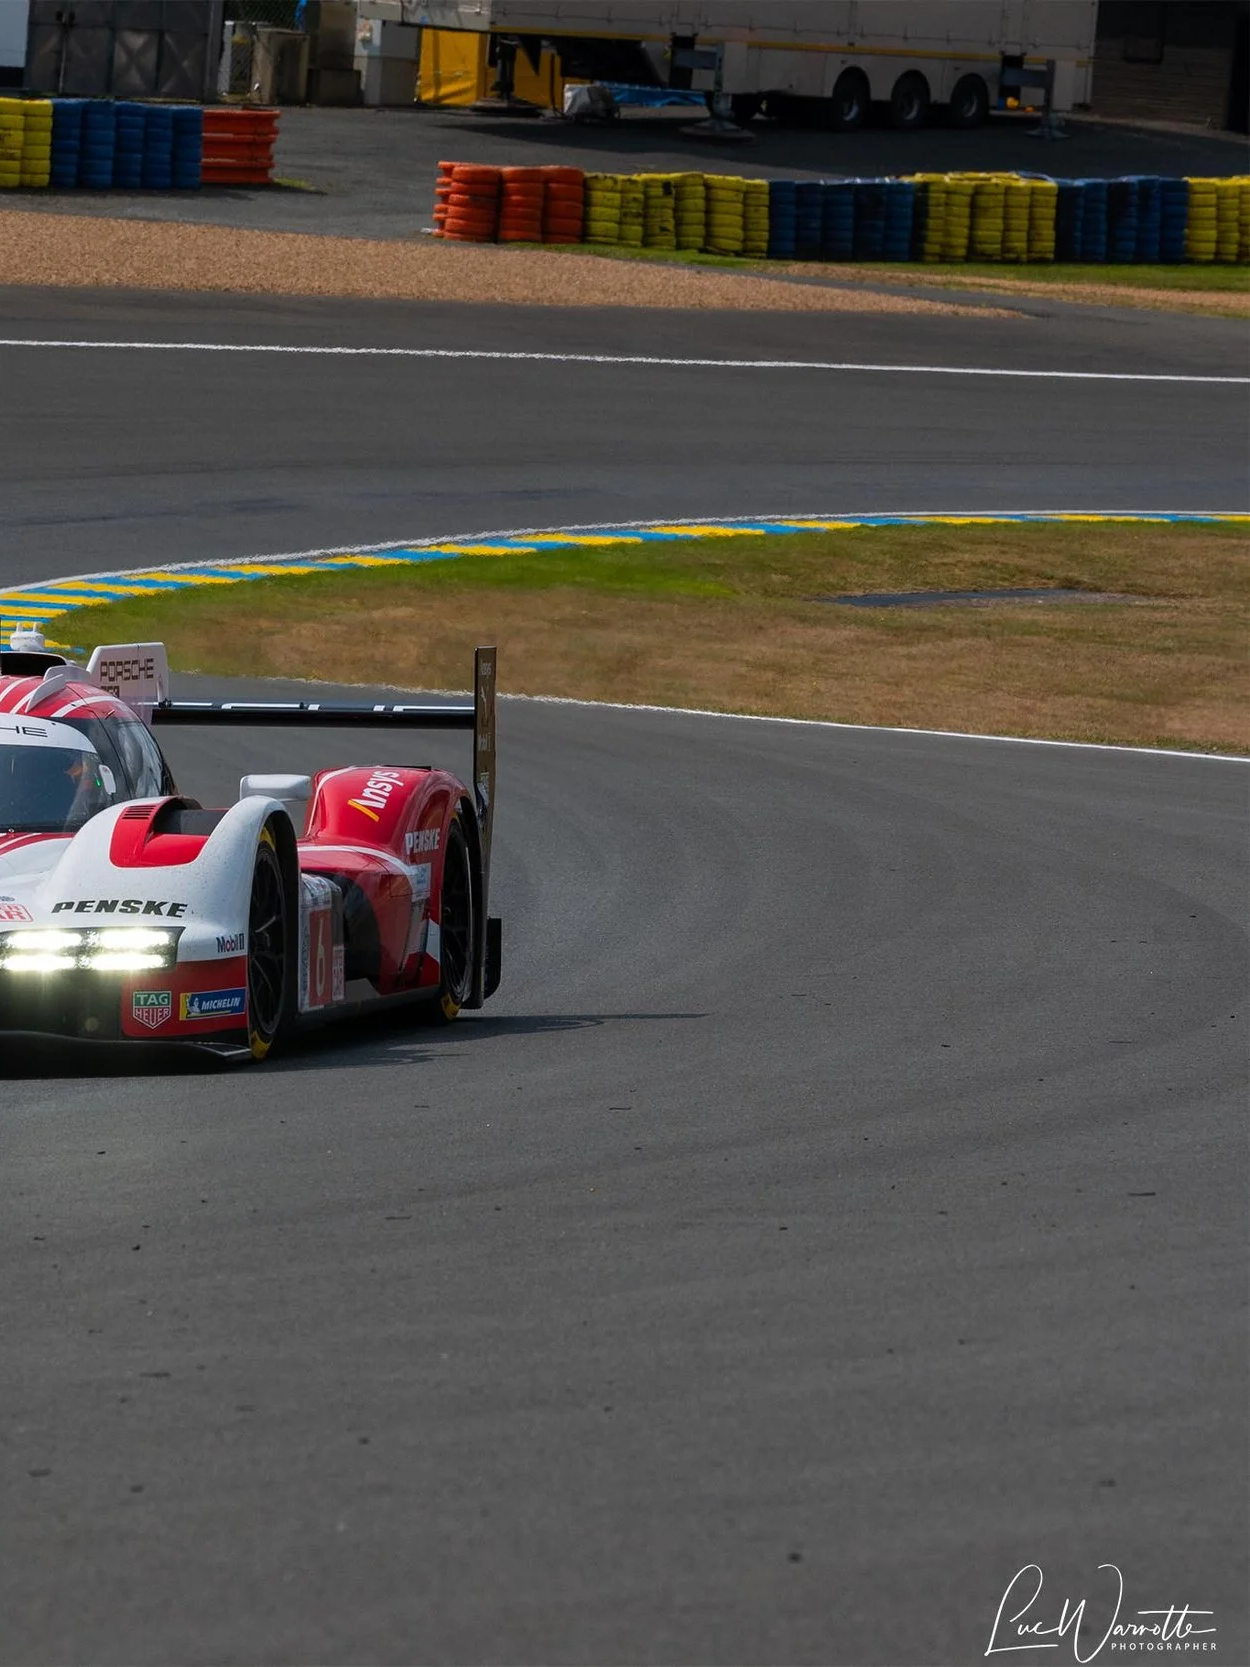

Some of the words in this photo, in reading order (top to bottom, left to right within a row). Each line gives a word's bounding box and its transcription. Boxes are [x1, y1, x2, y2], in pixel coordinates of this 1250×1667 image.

[100, 658, 154, 682] PORSCHE
[405, 828, 440, 856] PENSKE
[51, 899, 188, 918] PENSKE
[316, 917, 326, 997] 6
[136, 994, 169, 1005] TAG
[201, 996, 241, 1011] MICHELIN
[135, 1007, 170, 1025] HEUER
